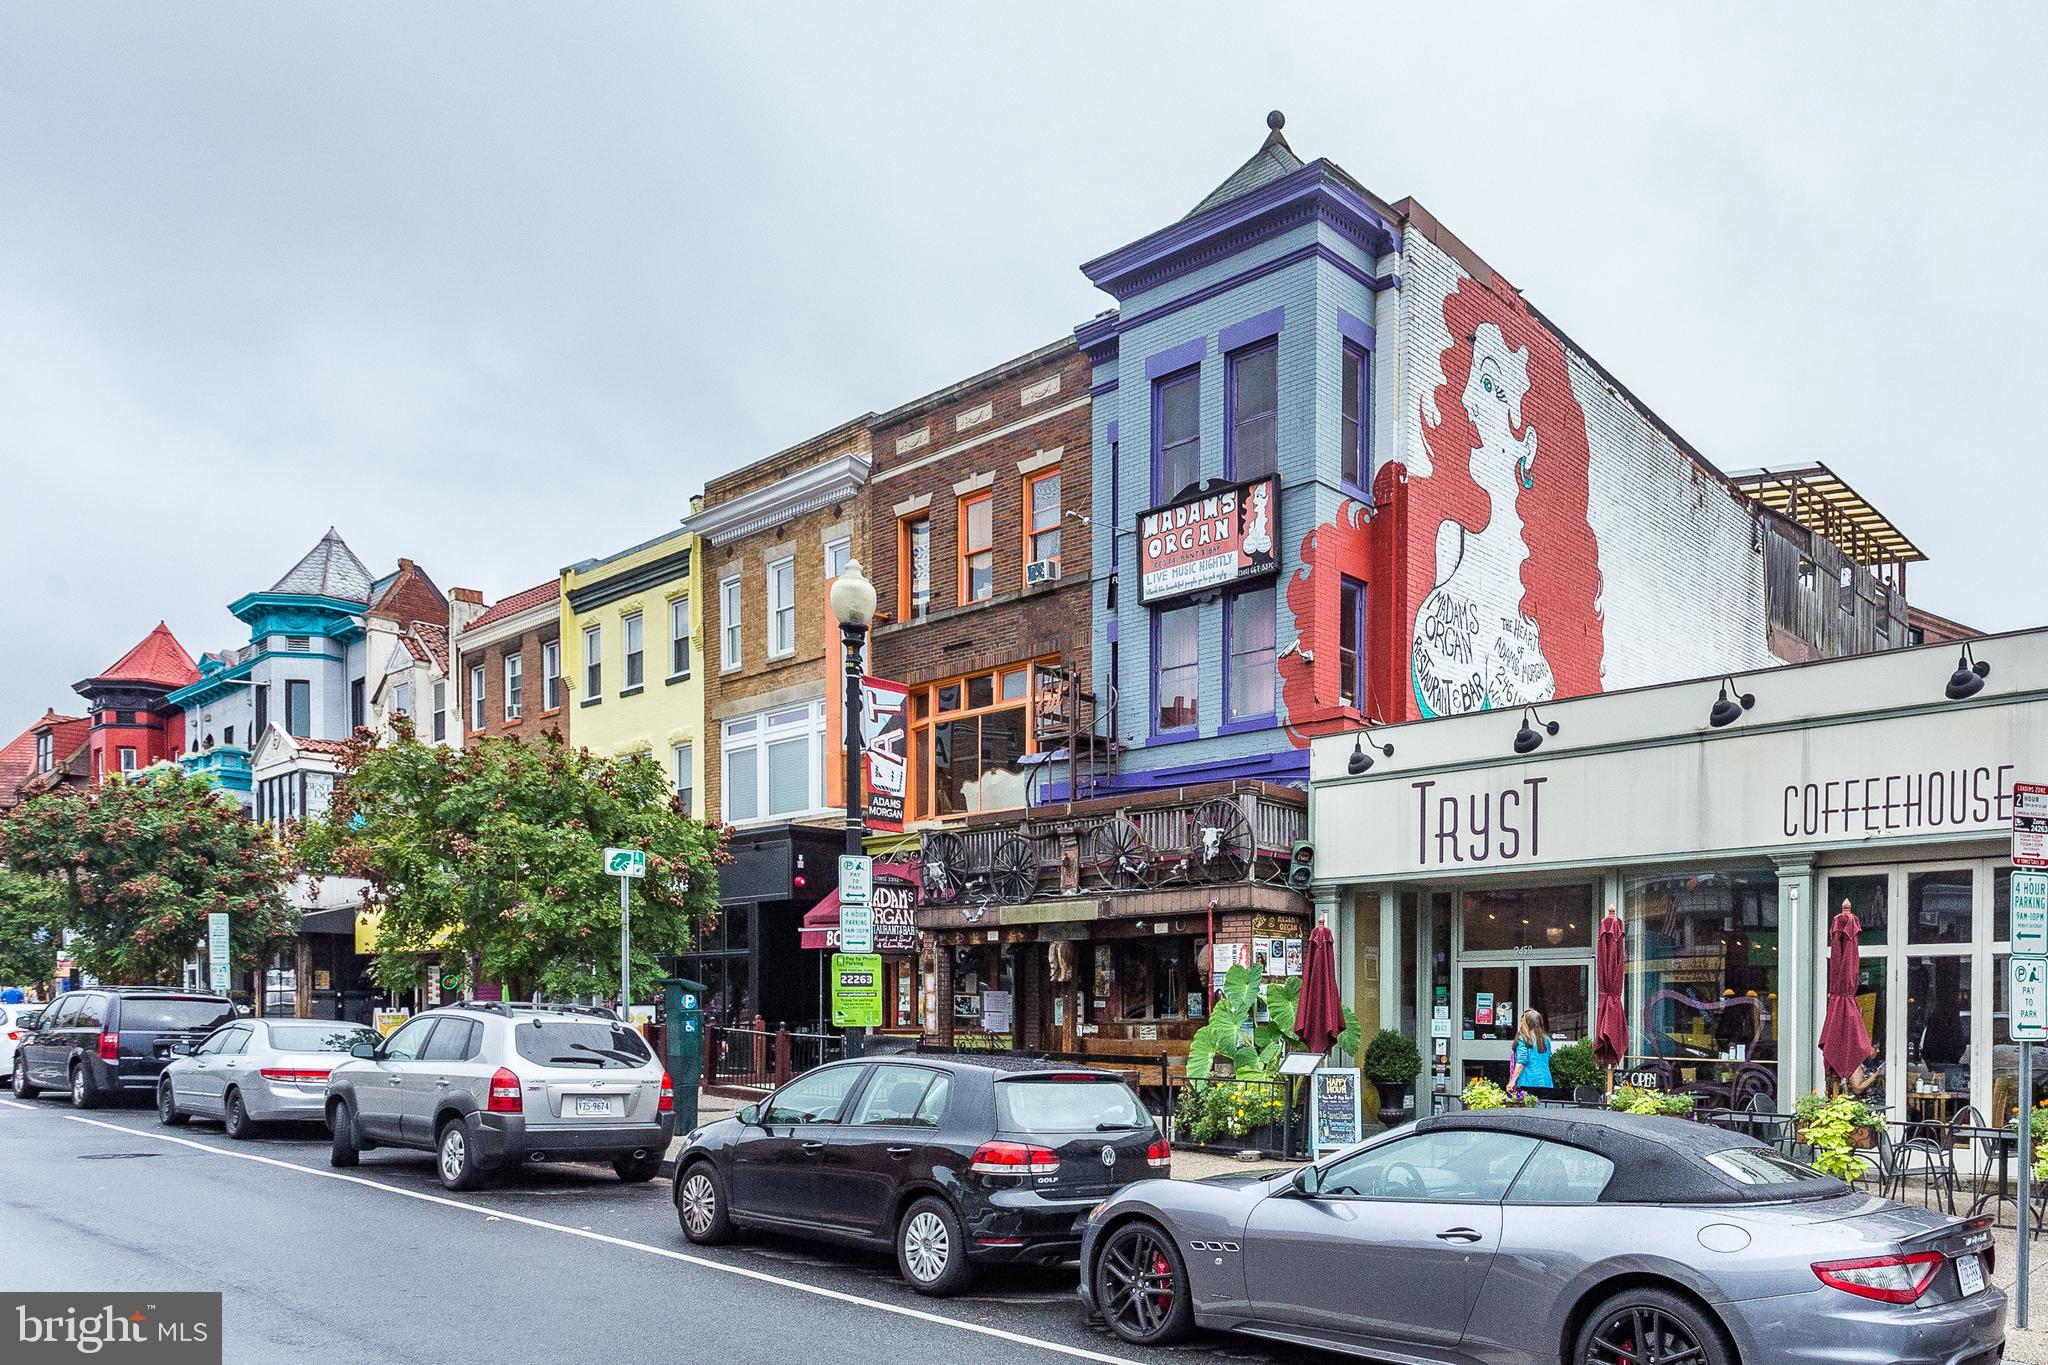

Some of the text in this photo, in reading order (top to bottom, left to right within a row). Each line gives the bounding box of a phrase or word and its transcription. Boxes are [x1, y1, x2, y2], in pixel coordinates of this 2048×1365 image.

[1143, 491, 1235, 538] MADAM'S
[1148, 518, 1230, 559] ORGAN
[1153, 550, 1199, 568] RESTAURANT
[1207, 545, 1221, 555] BAR
[1146, 553, 1233, 586] LIVE MUSIC NIGHTLY
[1427, 591, 1479, 634] MADAM'S
[1425, 615, 1473, 664] ORGAN
[1500, 617, 1538, 652] THE HEART
[1413, 636, 1453, 715] RESTAURANT
[1461, 672, 1485, 711] BAR
[1521, 661, 1549, 685] MORGAN
[868, 690, 905, 793] EAT
[2017, 785, 2046, 794] LOADING ZONE
[872, 797, 902, 809] ADAMS
[1783, 765, 2014, 836] COFFEEHOUSE
[2016, 793, 2022, 807] 2
[868, 807, 903, 820] MORGAN
[2015, 882, 2046, 895] 4 HOUR
[866, 888, 914, 909] ADAM'S
[2015, 895, 2046, 909] PARKING
[873, 908, 914, 925] RGAN
[2016, 912, 2044, 921] 9AM-10PM
[903, 926, 915, 936] BAR
[841, 975, 873, 984] 22263
[2022, 986, 2035, 995] PAY
[2025, 998, 2033, 1007] TO
[2020, 1010, 2037, 1019] PARK
[1326, 1077, 1348, 1087] HAPPY
[1631, 1072, 1657, 1088] OPEN
[1326, 1085, 1347, 1094] HOUR
